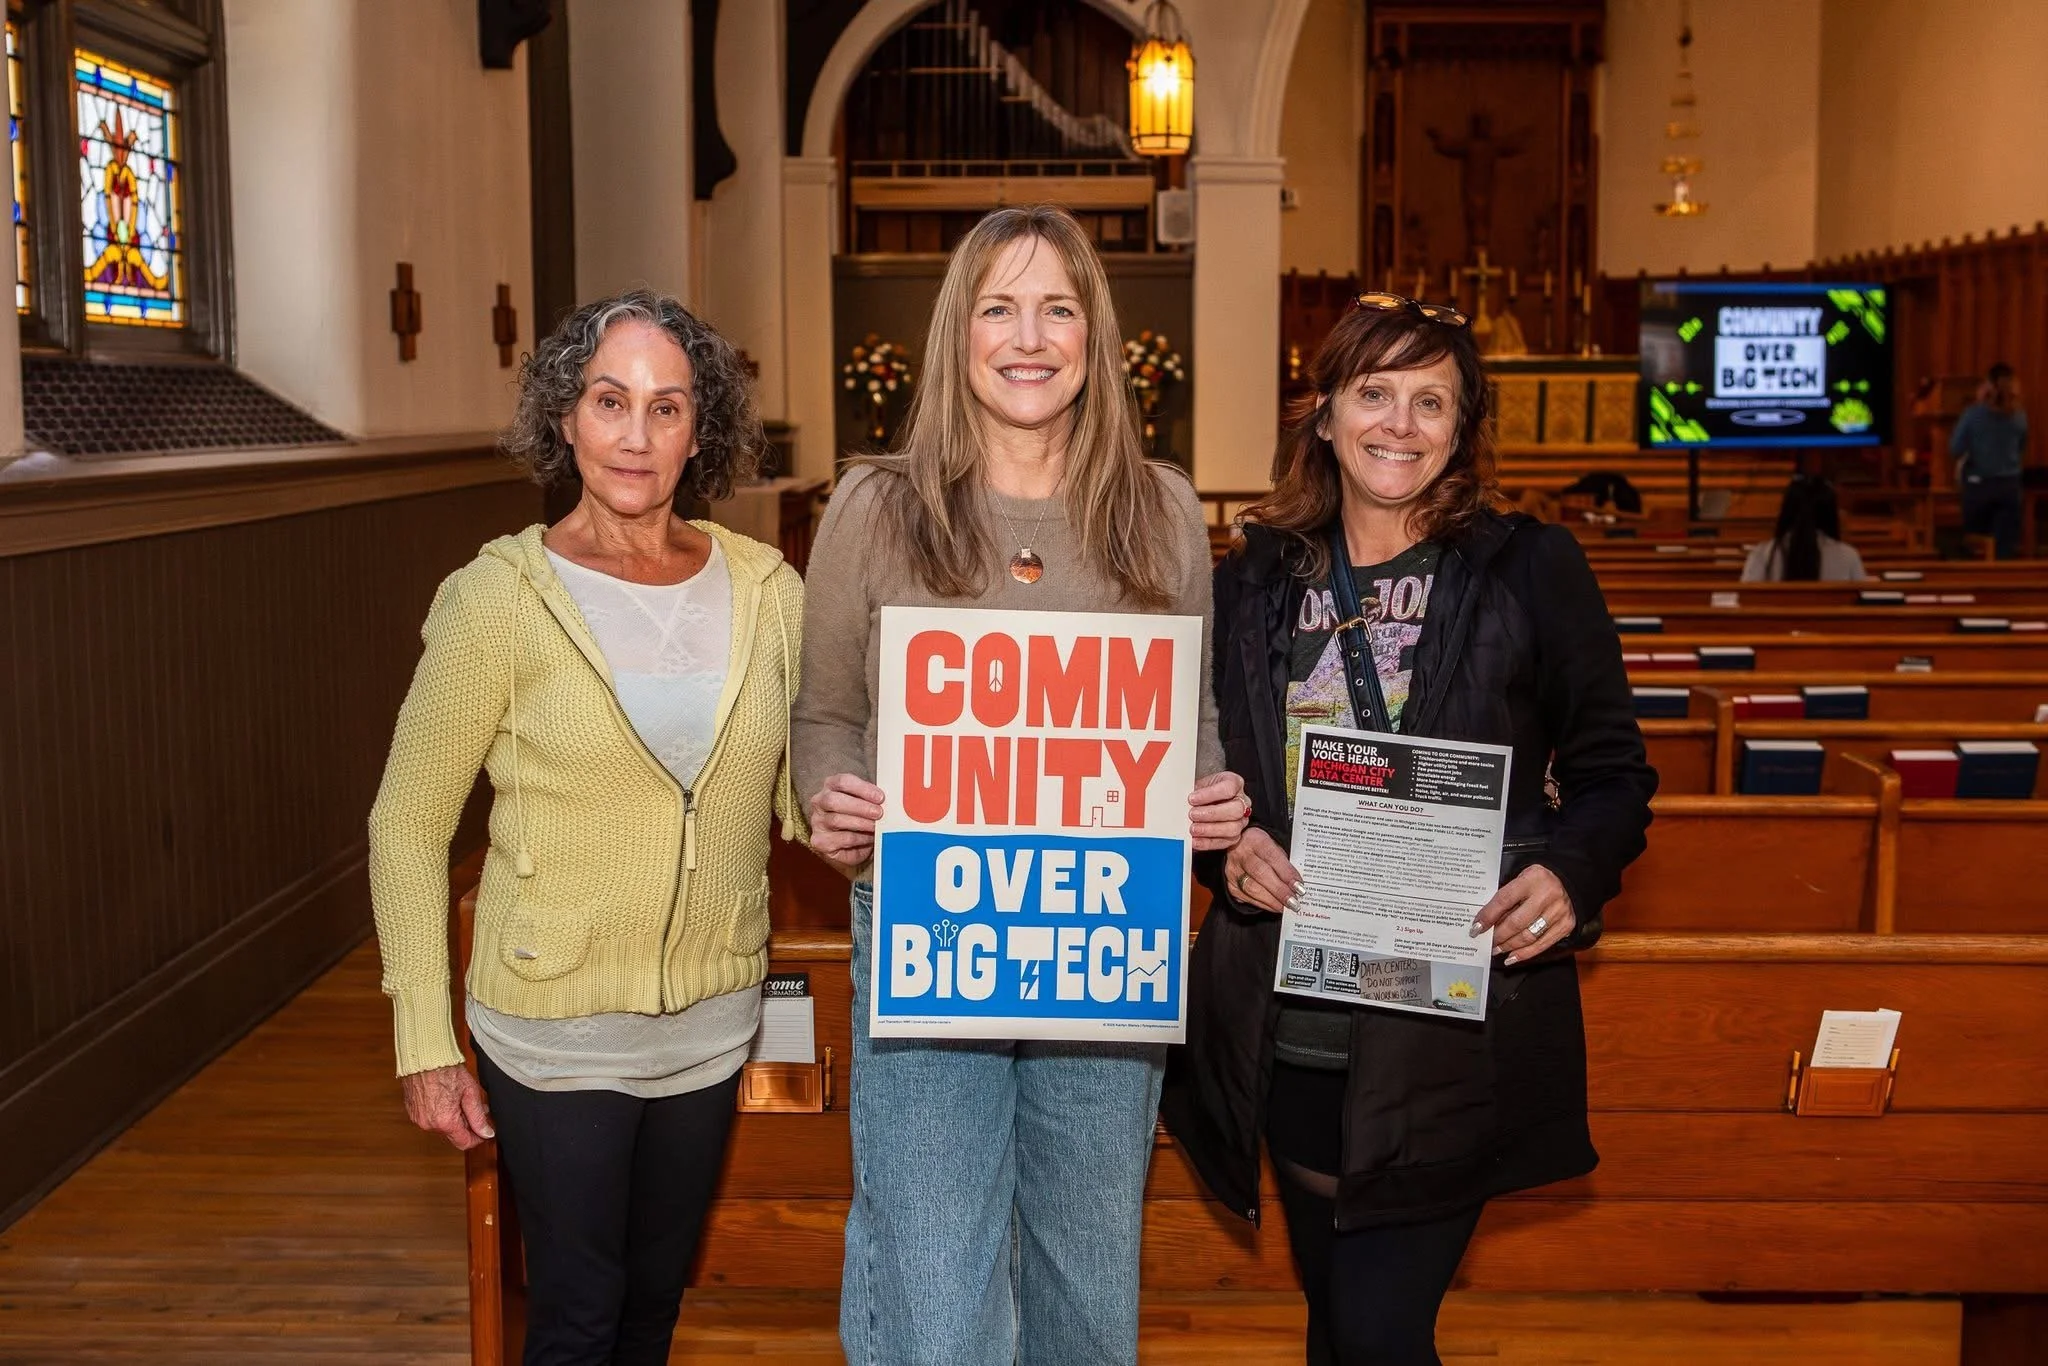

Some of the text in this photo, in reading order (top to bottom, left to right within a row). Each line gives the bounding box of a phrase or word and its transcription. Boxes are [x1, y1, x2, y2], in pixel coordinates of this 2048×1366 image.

[1718, 306, 1823, 337] COMMUNITY
[1745, 343, 1796, 362] OVER
[1762, 367, 1818, 389] TECH
[905, 629, 1175, 731] COMM
[1312, 739, 1378, 756] MAKE YOUR
[1311, 749, 1388, 767] VOICE HEARD!
[1309, 769, 1383, 786] DATA CENTER
[1310, 759, 1394, 778] MICHIGAN CITY
[902, 734, 1172, 829] UNITY
[934, 845, 1130, 916] OVER
[1006, 926, 1170, 1003] TECH
[1360, 958, 1418, 978] DATA CENTERS
[764, 980, 804, 990] come
[1366, 978, 1378, 988] DO
[1379, 978, 1393, 986] NOT
